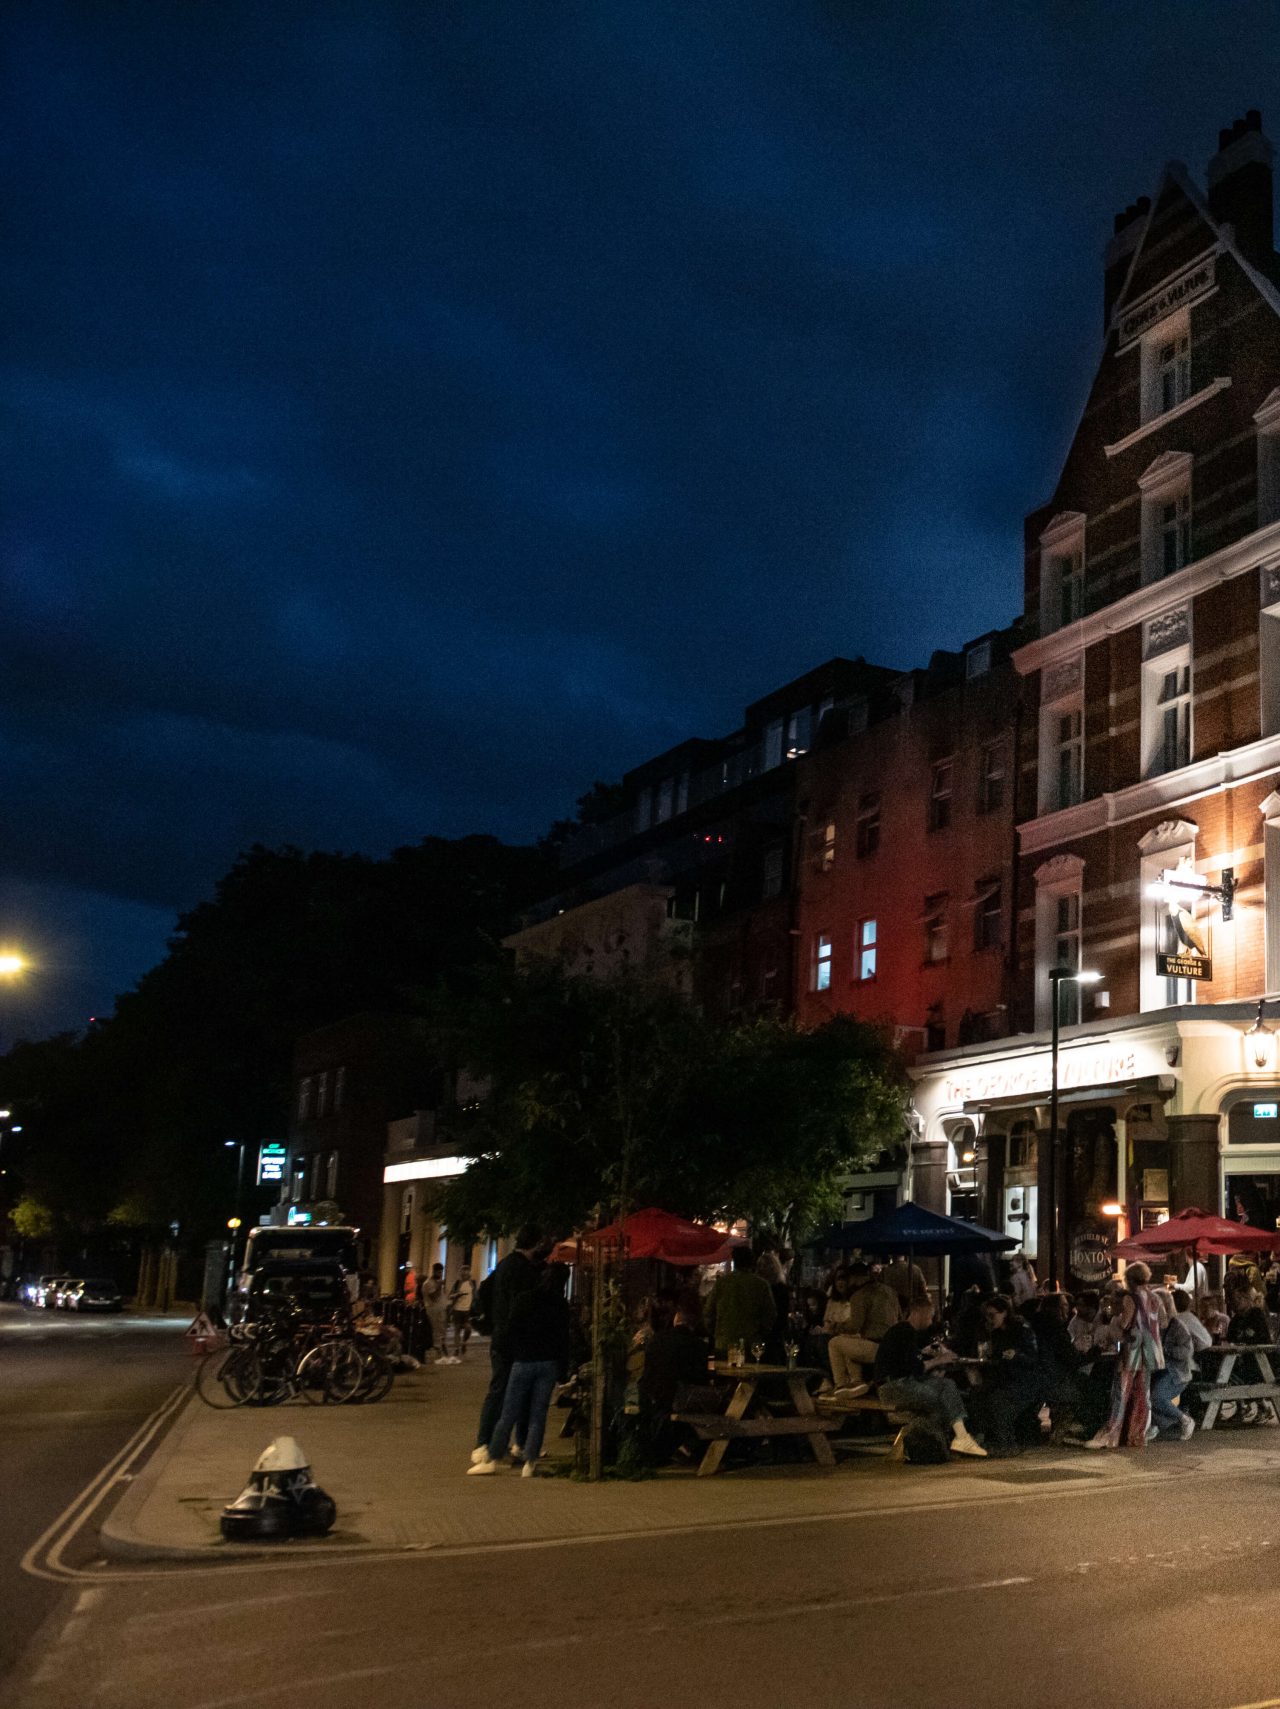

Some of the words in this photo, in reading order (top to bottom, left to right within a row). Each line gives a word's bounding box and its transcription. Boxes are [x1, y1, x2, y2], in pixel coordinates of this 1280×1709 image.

[1177, 958, 1197, 966] GEORGE
[1166, 964, 1203, 976] VULTURE
[945, 1078, 972, 1103] THE
[1069, 1249, 1112, 1265] HOXTON
